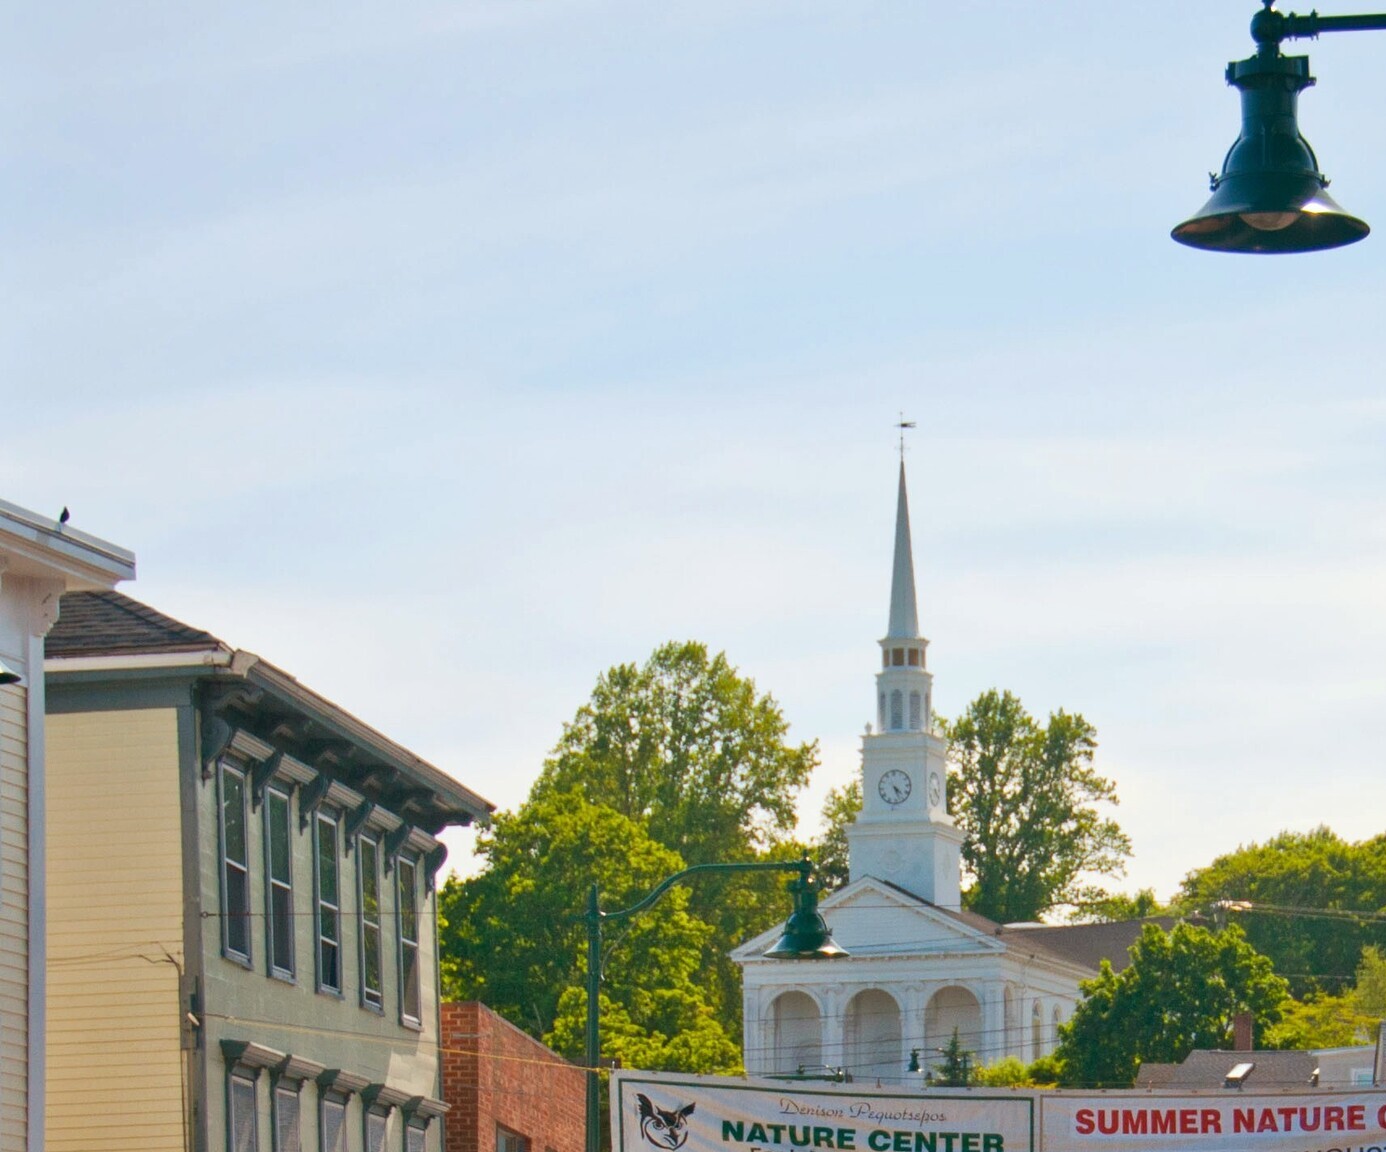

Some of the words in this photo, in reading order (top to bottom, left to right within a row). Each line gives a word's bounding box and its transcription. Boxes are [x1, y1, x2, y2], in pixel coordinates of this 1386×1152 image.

[780, 1098, 844, 1118] Denison
[850, 1102, 947, 1127] Pequotsepos
[1075, 1108, 1222, 1135] SUMMER
[1233, 1105, 1366, 1134] NATURE
[721, 1121, 856, 1151] NATURE
